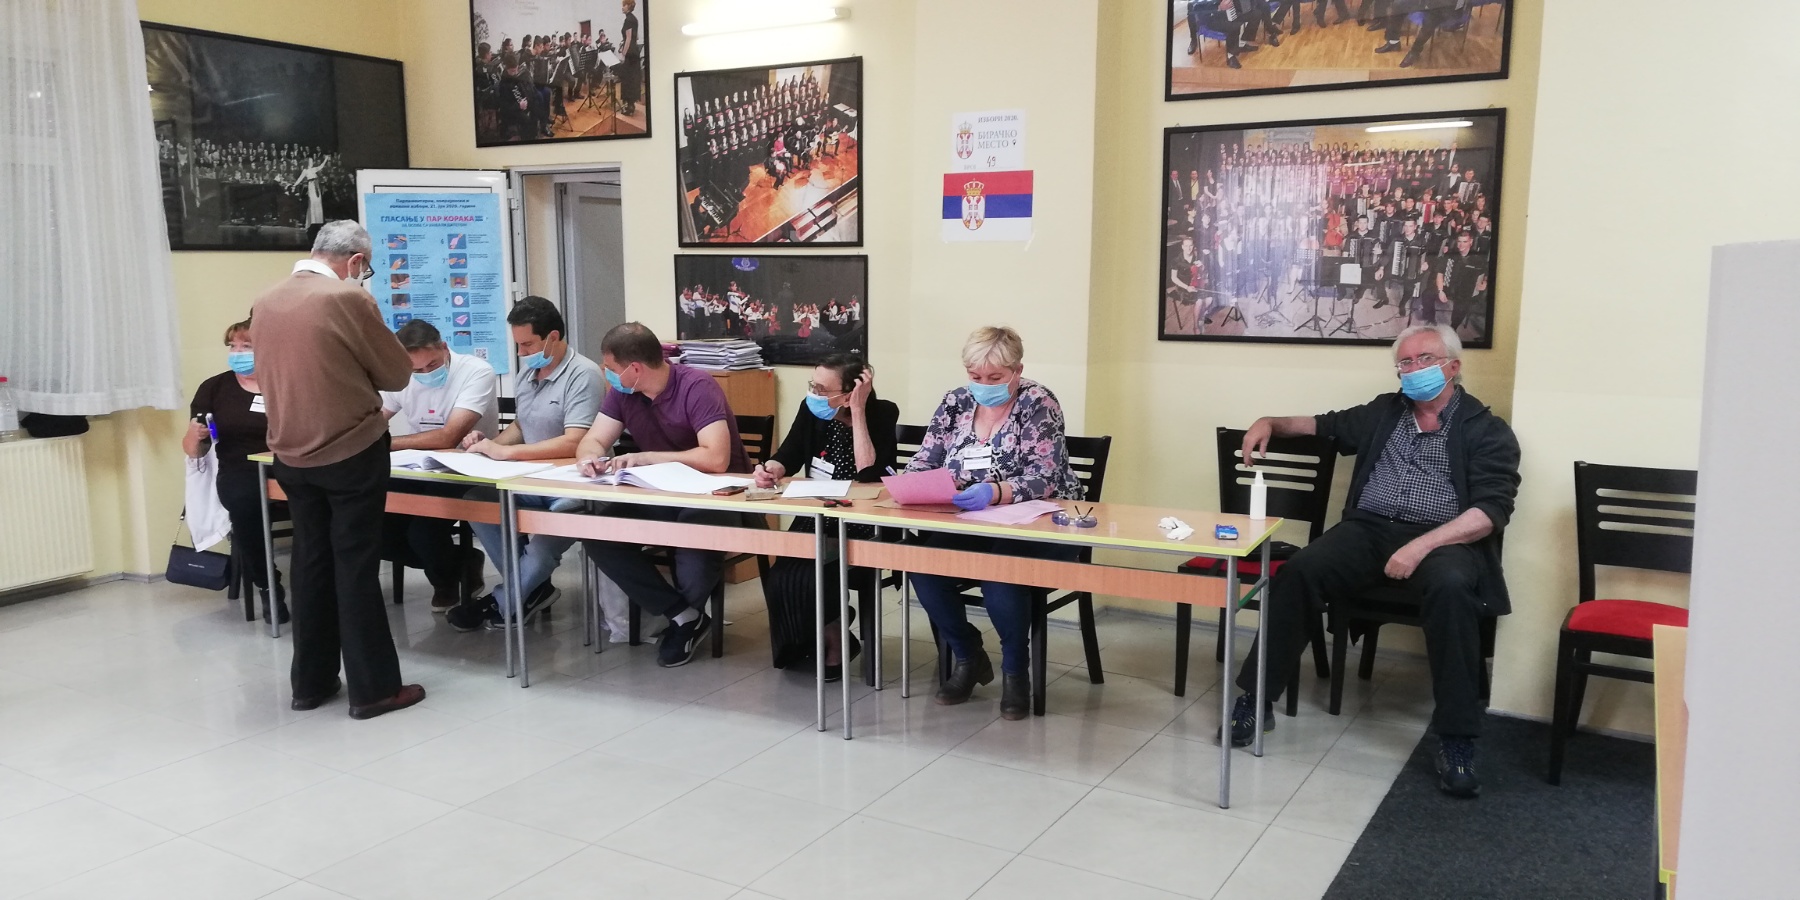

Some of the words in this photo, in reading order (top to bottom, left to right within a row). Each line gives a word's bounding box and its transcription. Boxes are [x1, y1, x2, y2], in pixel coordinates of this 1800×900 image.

[978, 115, 1003, 123] ИЗБОРИ
[978, 130, 1018, 140] БИРАЧКО
[978, 140, 1009, 149] МЕСТО
[986, 156, 996, 168] 49
